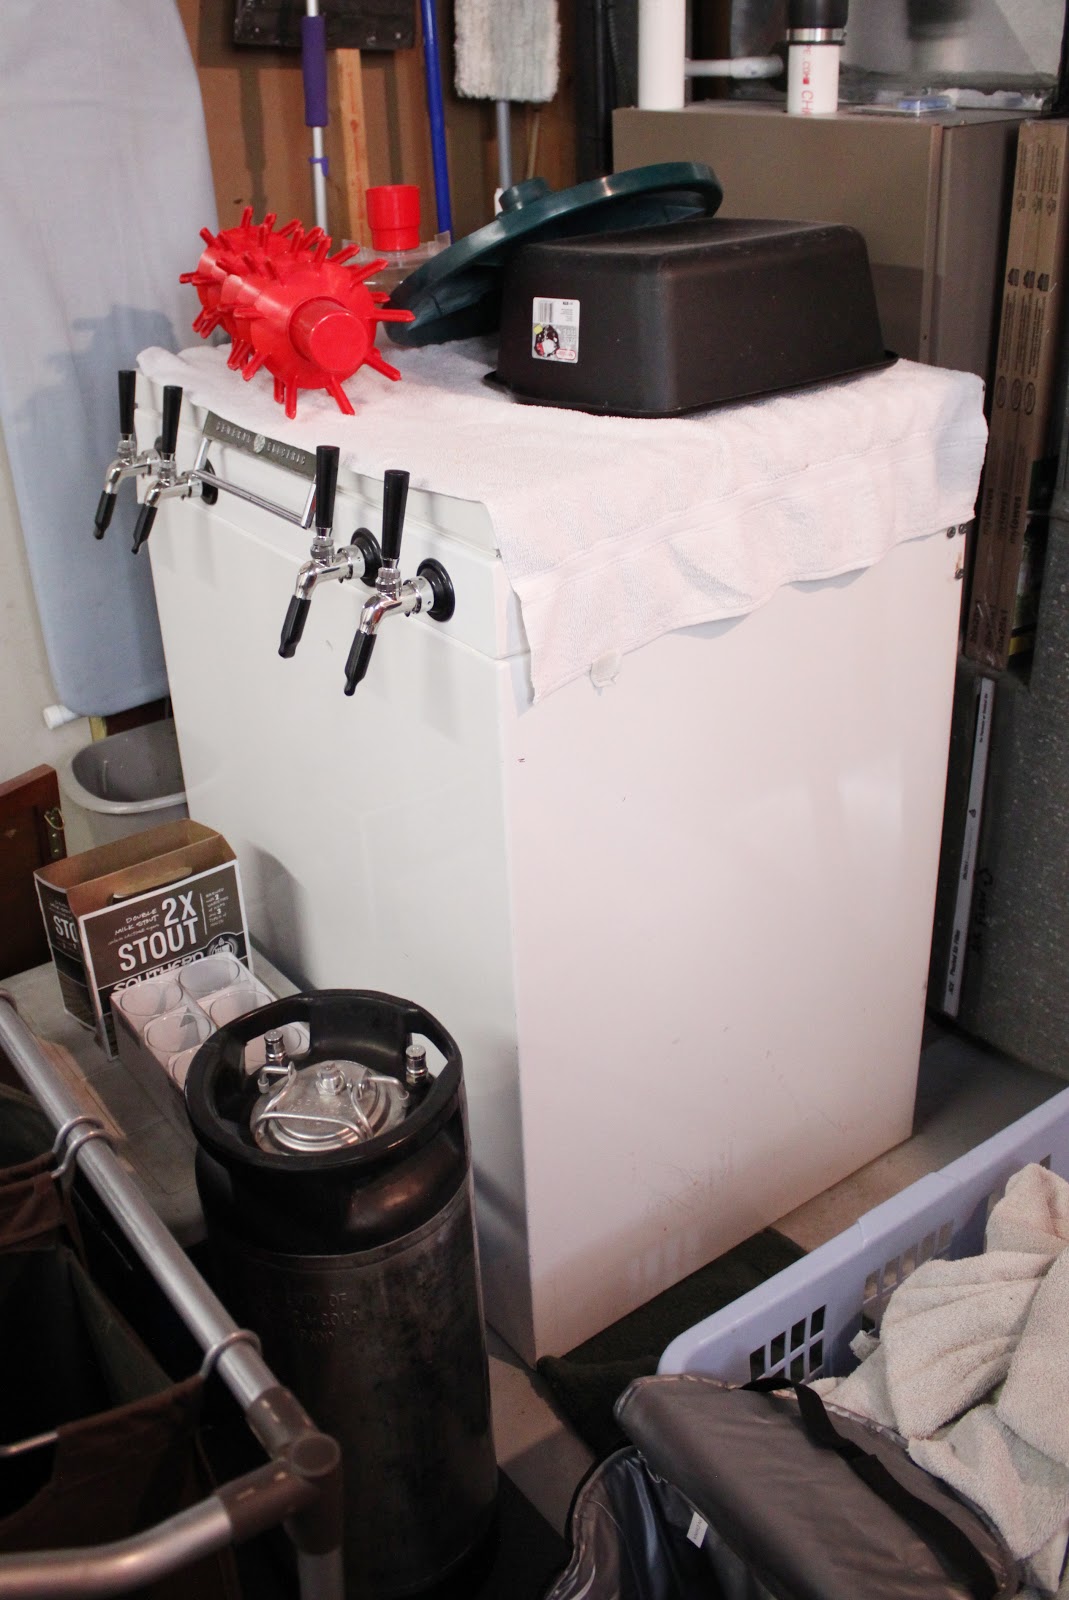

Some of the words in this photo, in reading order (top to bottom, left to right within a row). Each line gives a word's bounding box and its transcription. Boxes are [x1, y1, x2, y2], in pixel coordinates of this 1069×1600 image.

[215, 422, 251, 443] GENERAL
[267, 442, 306, 465] ELECTRIC
[125, 908, 157, 924] DOUBLE
[161, 891, 198, 927] 2X
[114, 924, 134, 935] MILK
[118, 917, 198, 972] STOUT
